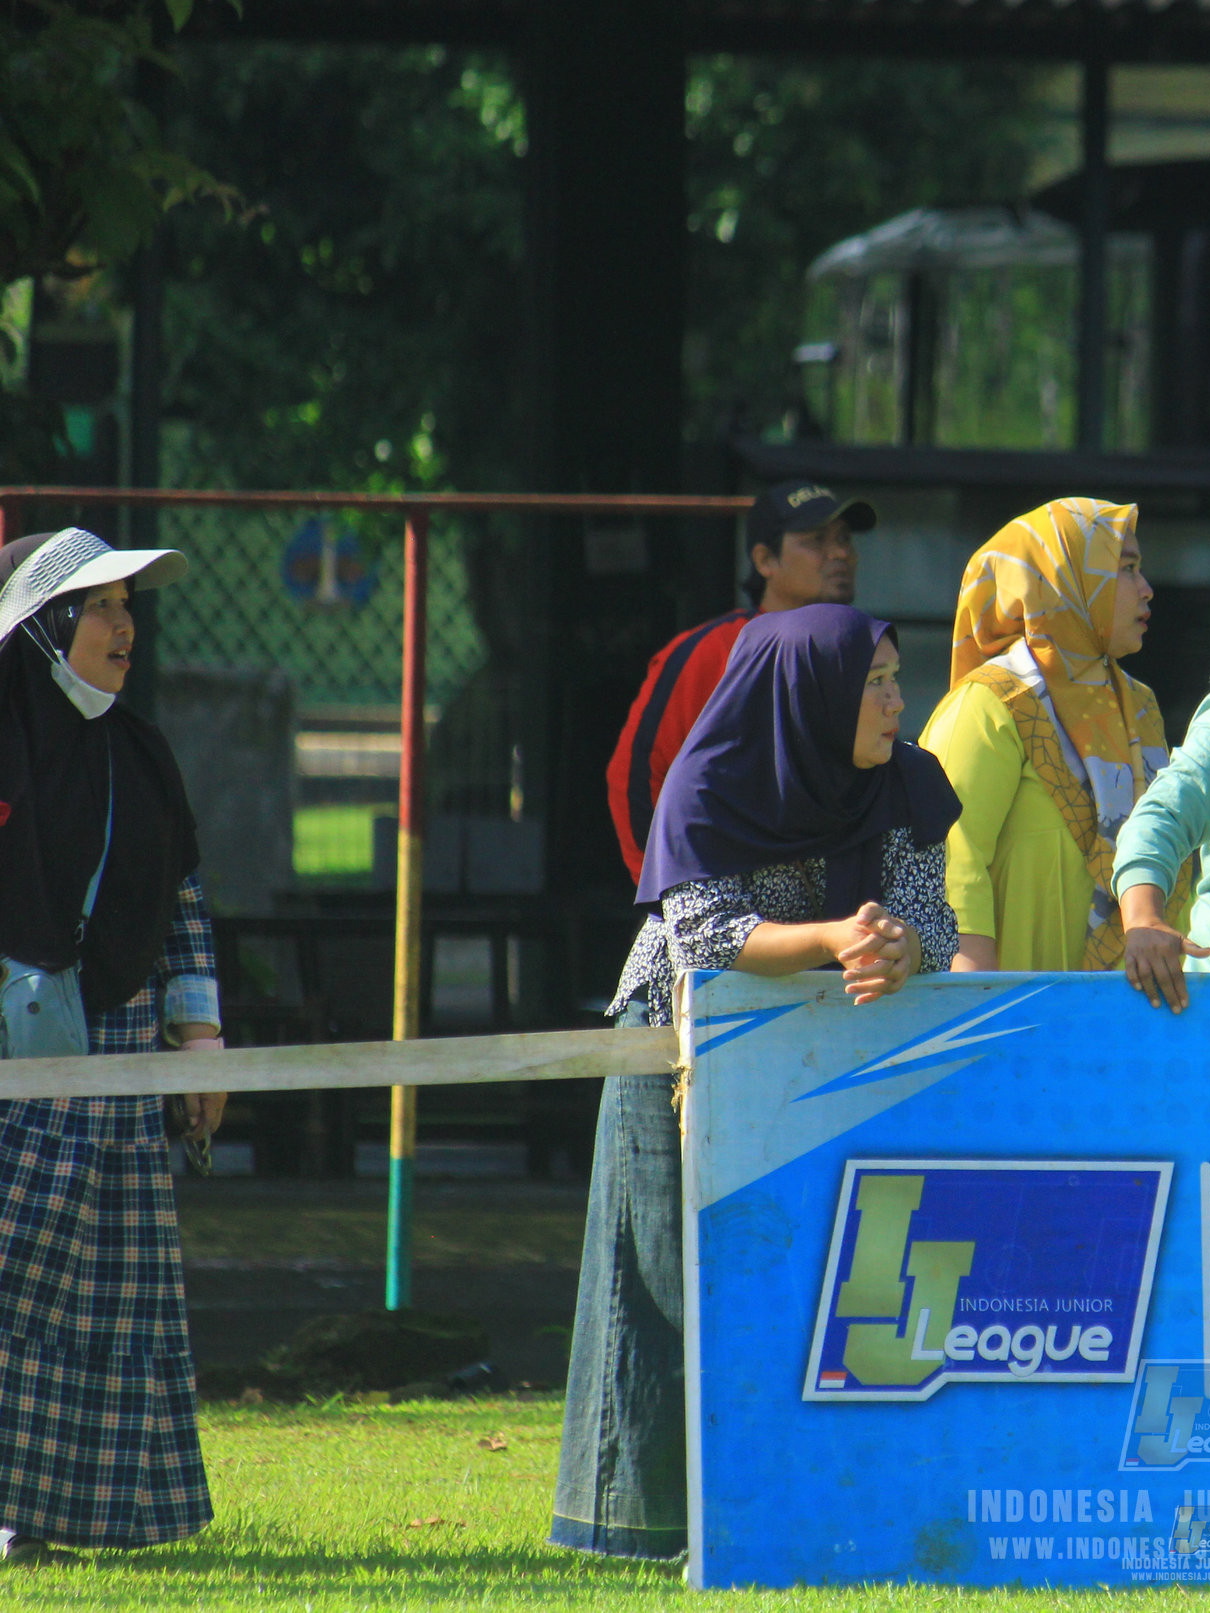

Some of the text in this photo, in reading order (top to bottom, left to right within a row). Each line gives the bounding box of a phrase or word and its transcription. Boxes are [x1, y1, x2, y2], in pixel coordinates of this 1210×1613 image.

[960, 1298, 1113, 1312] INDONESIA JUNIOR
[910, 1308, 1113, 1377] League
